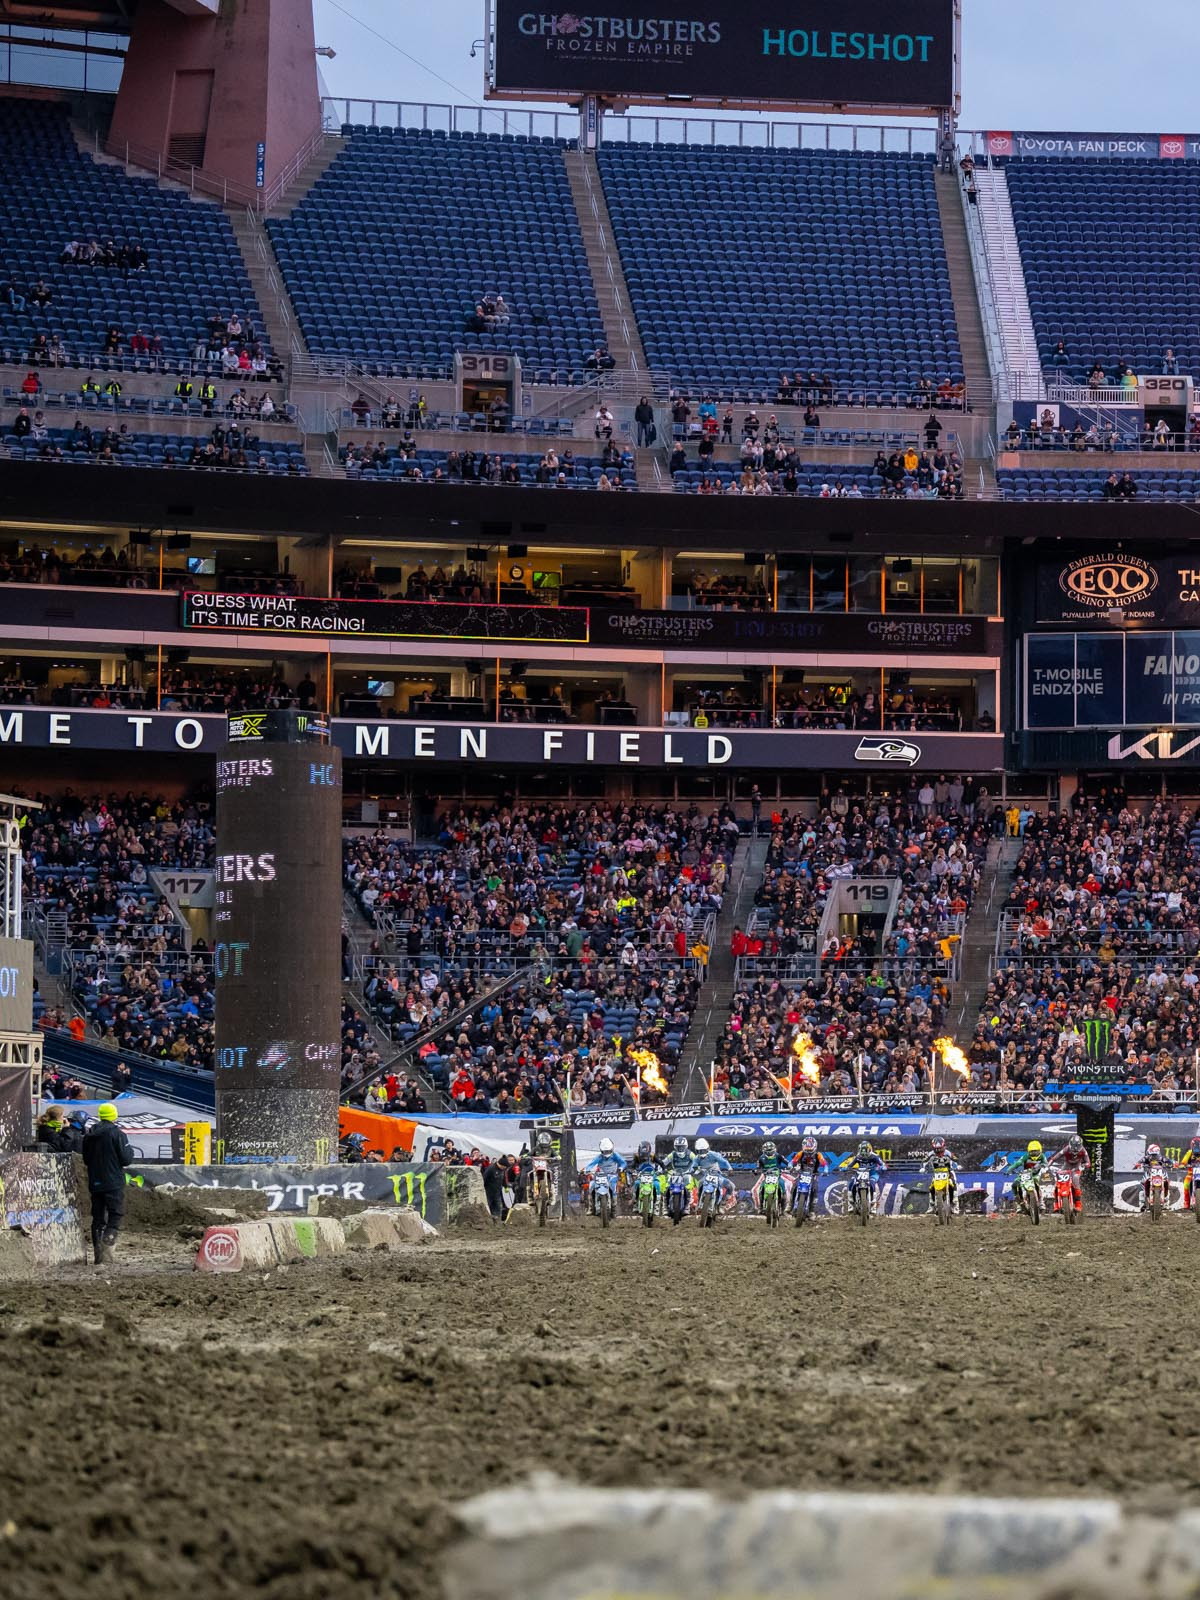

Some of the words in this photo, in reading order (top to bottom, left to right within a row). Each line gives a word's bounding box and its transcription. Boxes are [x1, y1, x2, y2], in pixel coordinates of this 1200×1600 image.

[546, 38, 617, 53] FROZEN
[628, 42, 693, 55] EMPIRE
[762, 28, 934, 62] HOLESHOT
[1017, 138, 1074, 151] TOYOTA
[1078, 139, 1104, 152] FAN
[1108, 139, 1147, 153] DECK
[463, 356, 509, 372] 318
[1146, 378, 1185, 390] 320
[1068, 553, 1114, 571] EMERALD
[1117, 553, 1149, 569] QUEEN
[1080, 567, 1141, 597] EQC
[191, 593, 245, 609] GUESS
[249, 596, 297, 611] WHAT.
[1068, 590, 1105, 607] CASINO
[1116, 590, 1151, 607] HOTEL
[191, 610, 218, 625] IT'S
[222, 611, 259, 627] TIME
[263, 613, 297, 628] FOR
[301, 615, 365, 632] RACING!
[1034, 668, 1102, 680] T-MOBILE
[1032, 682, 1103, 696] ENDZONE
[1163, 693, 1178, 705] IN
[129, 716, 203, 751] TO
[543, 730, 733, 764] FIELD
[162, 878, 207, 894] 117
[846, 885, 888, 899] 119
[1067, 1064, 1125, 1074] MONSTER
[759, 1125, 902, 1136] YAMAHA
